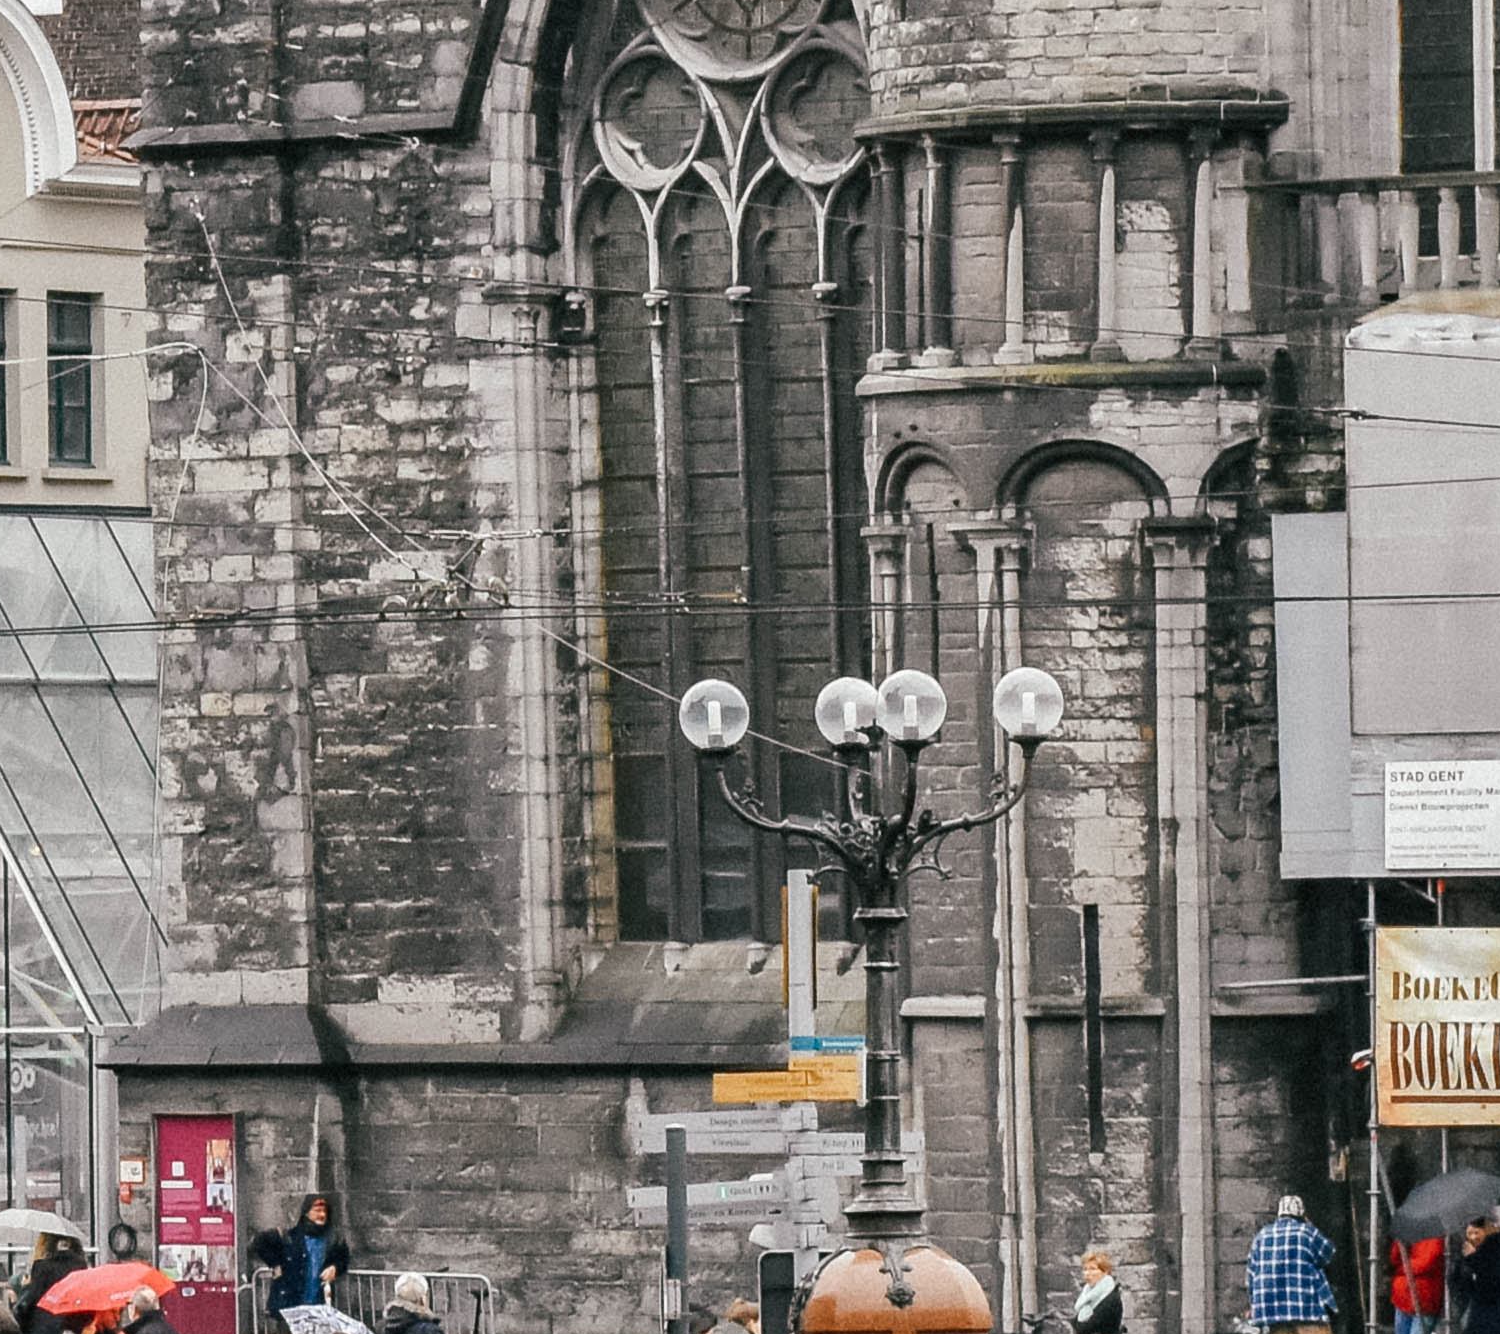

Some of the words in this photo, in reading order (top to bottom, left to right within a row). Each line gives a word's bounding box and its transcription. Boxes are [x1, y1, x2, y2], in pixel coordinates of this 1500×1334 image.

[1390, 771, 1424, 782] STAD
[1428, 770, 1465, 782] GENT
[1389, 788, 1448, 797] Departement
[1450, 787, 1483, 796] Facility
